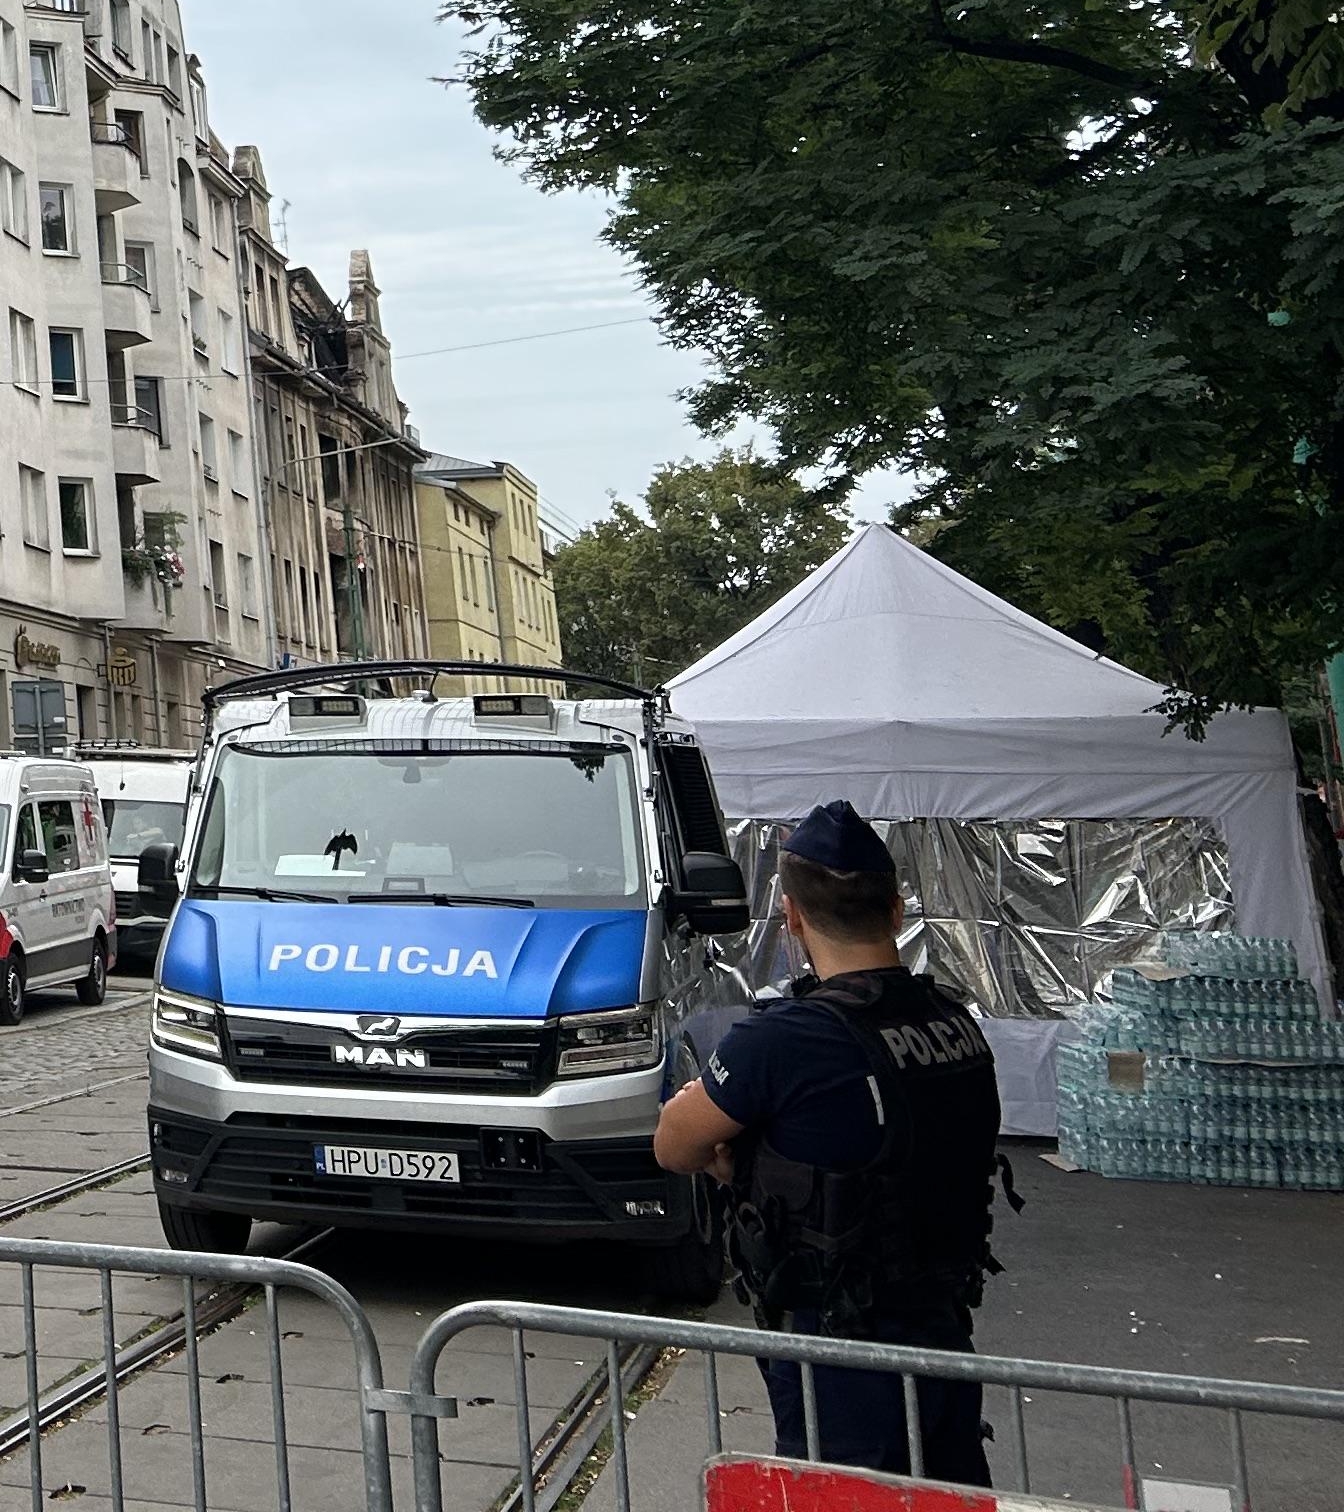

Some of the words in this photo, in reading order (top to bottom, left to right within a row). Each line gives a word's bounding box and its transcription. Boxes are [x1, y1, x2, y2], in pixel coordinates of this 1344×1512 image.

[268, 943, 499, 979] POLICJA
[334, 1045, 426, 1068] MAN
[879, 1016, 988, 1070] POLICJA
[330, 1148, 380, 1175] HPU
[388, 1152, 454, 1181] D592
